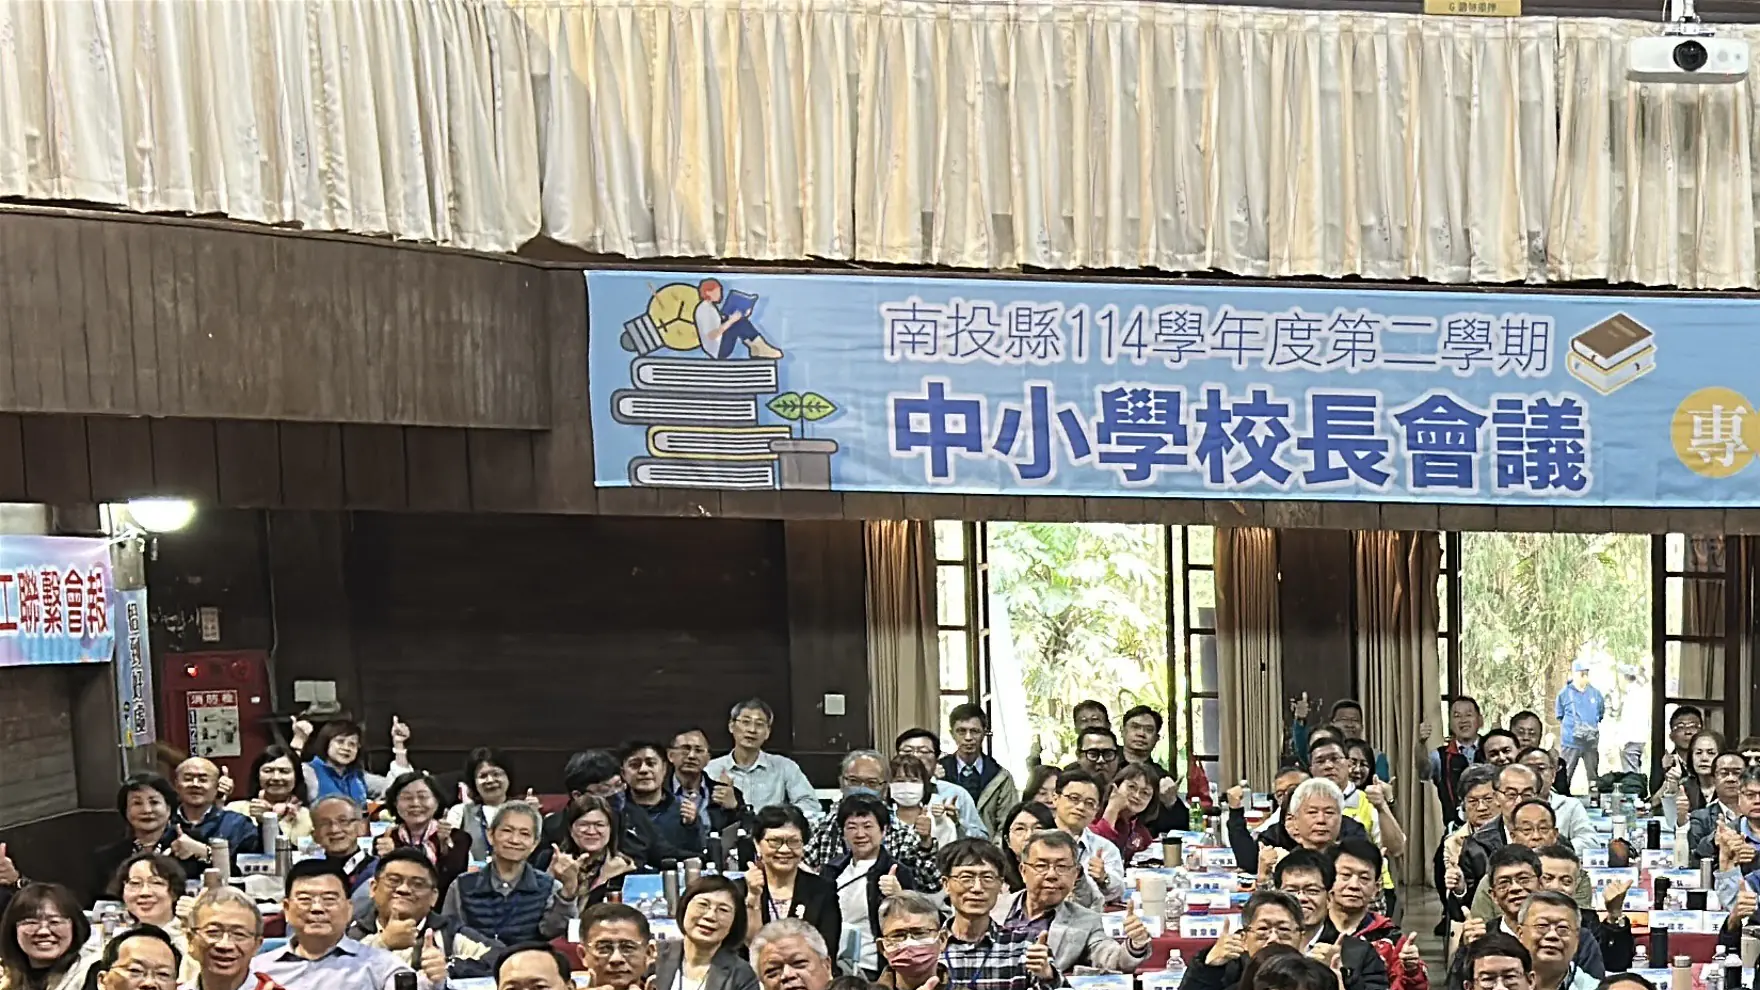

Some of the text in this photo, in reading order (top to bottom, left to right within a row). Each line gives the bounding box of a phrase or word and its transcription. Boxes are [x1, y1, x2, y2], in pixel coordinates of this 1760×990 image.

[883, 301, 1549, 375] 南投縣114學年度第二學期
[894, 381, 1588, 491] 中小學校長會議
